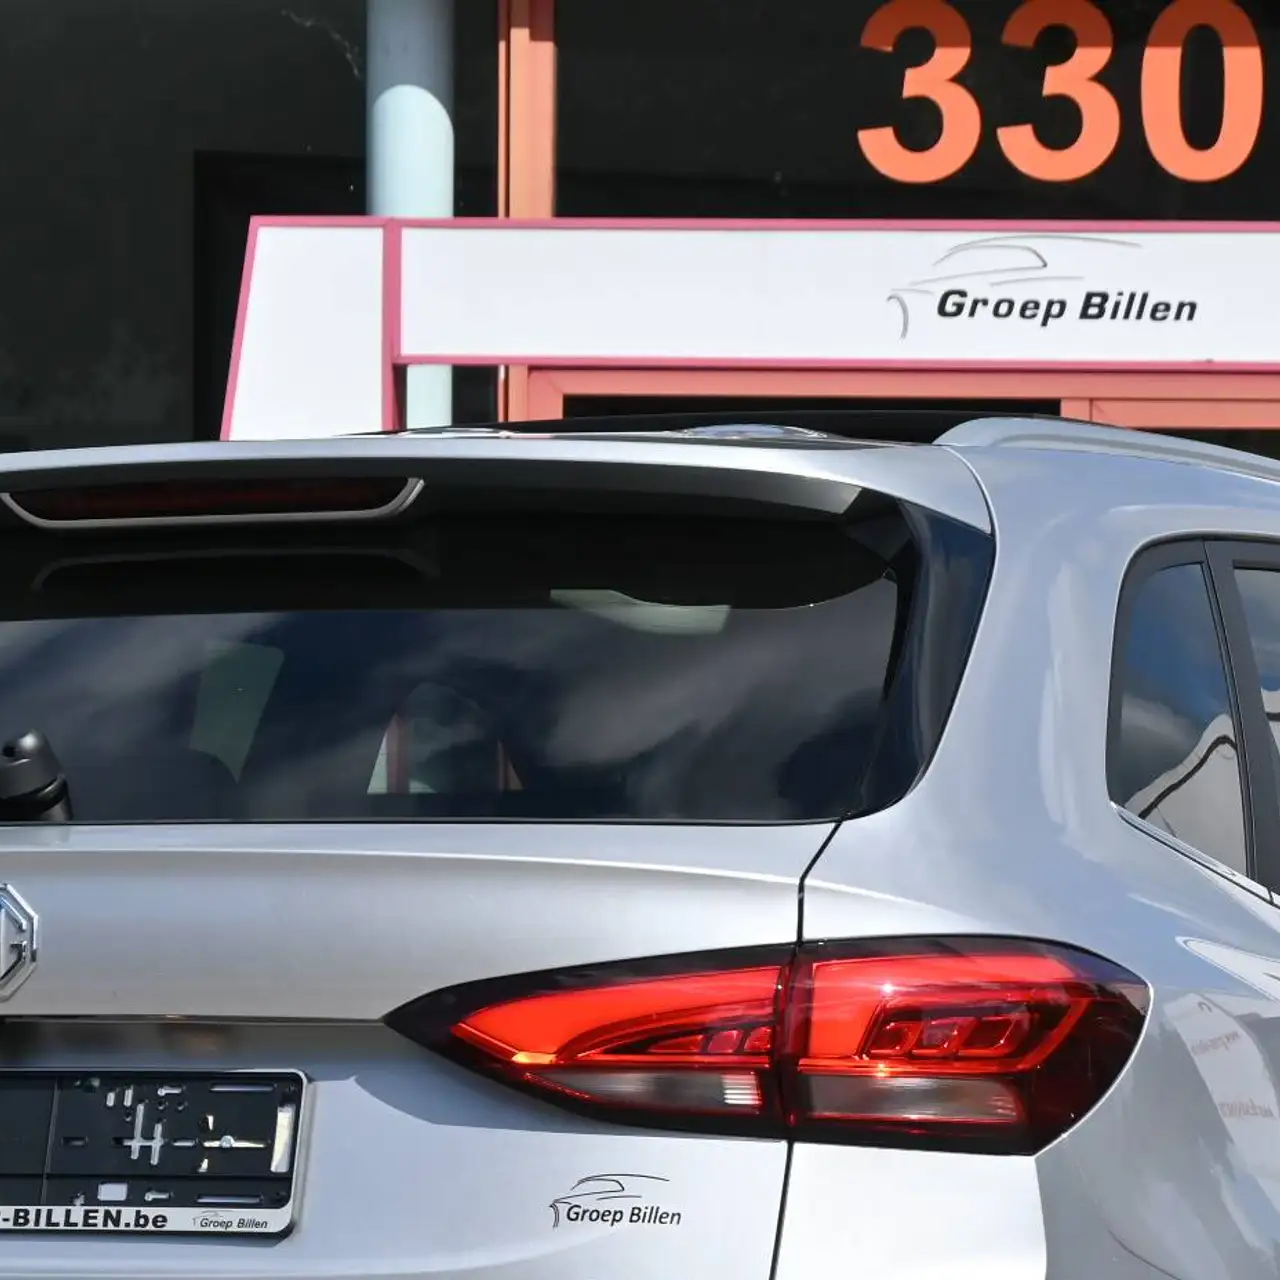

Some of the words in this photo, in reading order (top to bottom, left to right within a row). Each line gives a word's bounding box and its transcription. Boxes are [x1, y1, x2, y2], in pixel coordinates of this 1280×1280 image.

[857, 0, 1263, 183] 330
[936, 289, 1067, 327] Groep
[1079, 290, 1198, 321] Billen
[199, 1216, 233, 1231] Groep
[236, 1217, 268, 1230] Billen
[566, 1203, 624, 1227] Groep
[628, 1205, 682, 1226] Billen
